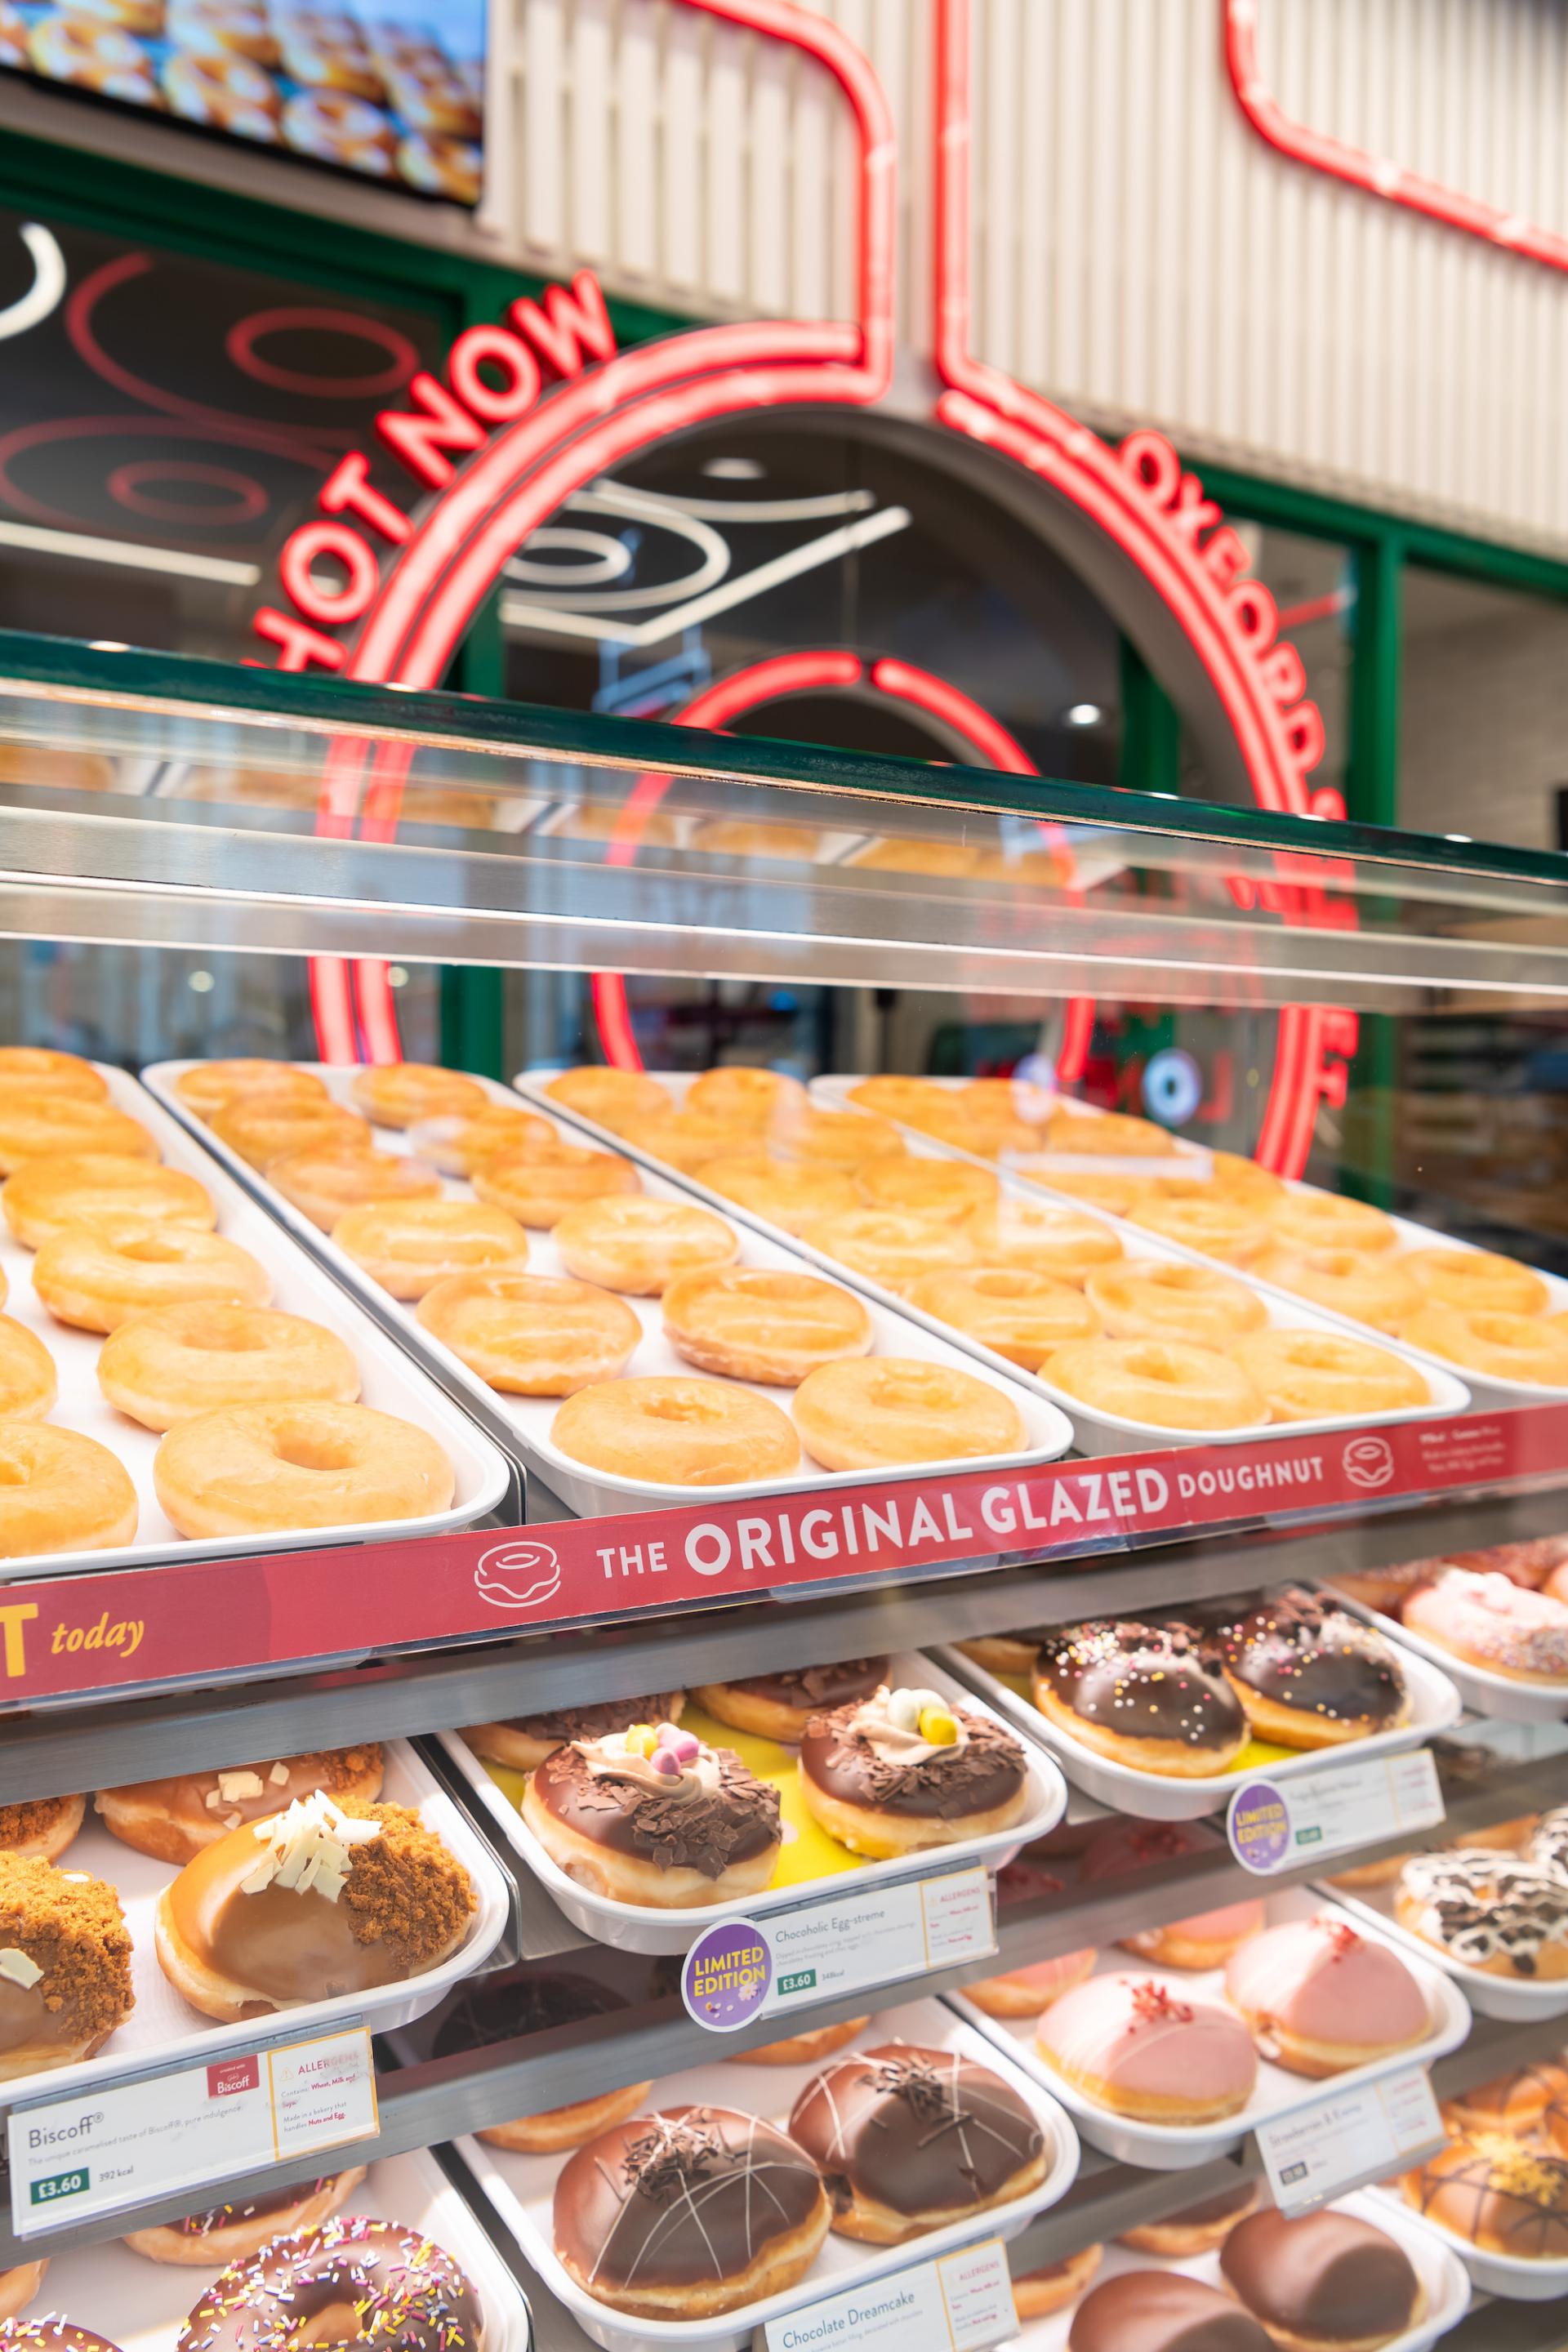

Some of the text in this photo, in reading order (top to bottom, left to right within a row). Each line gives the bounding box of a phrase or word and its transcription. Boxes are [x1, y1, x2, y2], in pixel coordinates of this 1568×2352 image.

[240, 267, 617, 671] HOT NOW
[596, 1457, 1323, 1578] THE ORIGINAL GLAZED DOUGHNUT
[51, 1612, 144, 1657] today
[1236, 1803, 1285, 1827] LIMITED
[1237, 1820, 1287, 1845] EDITION
[775, 1909, 885, 1943] Chocoholic Egg-streme
[695, 1947, 764, 1976] LIMITED
[694, 1965, 766, 1997] EDITION
[783, 1974, 811, 1990] £3.60
[217, 2074, 249, 2094] Biscoff
[38, 2166, 134, 2198] £3.60 392 kcal
[783, 2319, 845, 2349] Chocolate
[848, 2291, 915, 2325] Dreamcake
